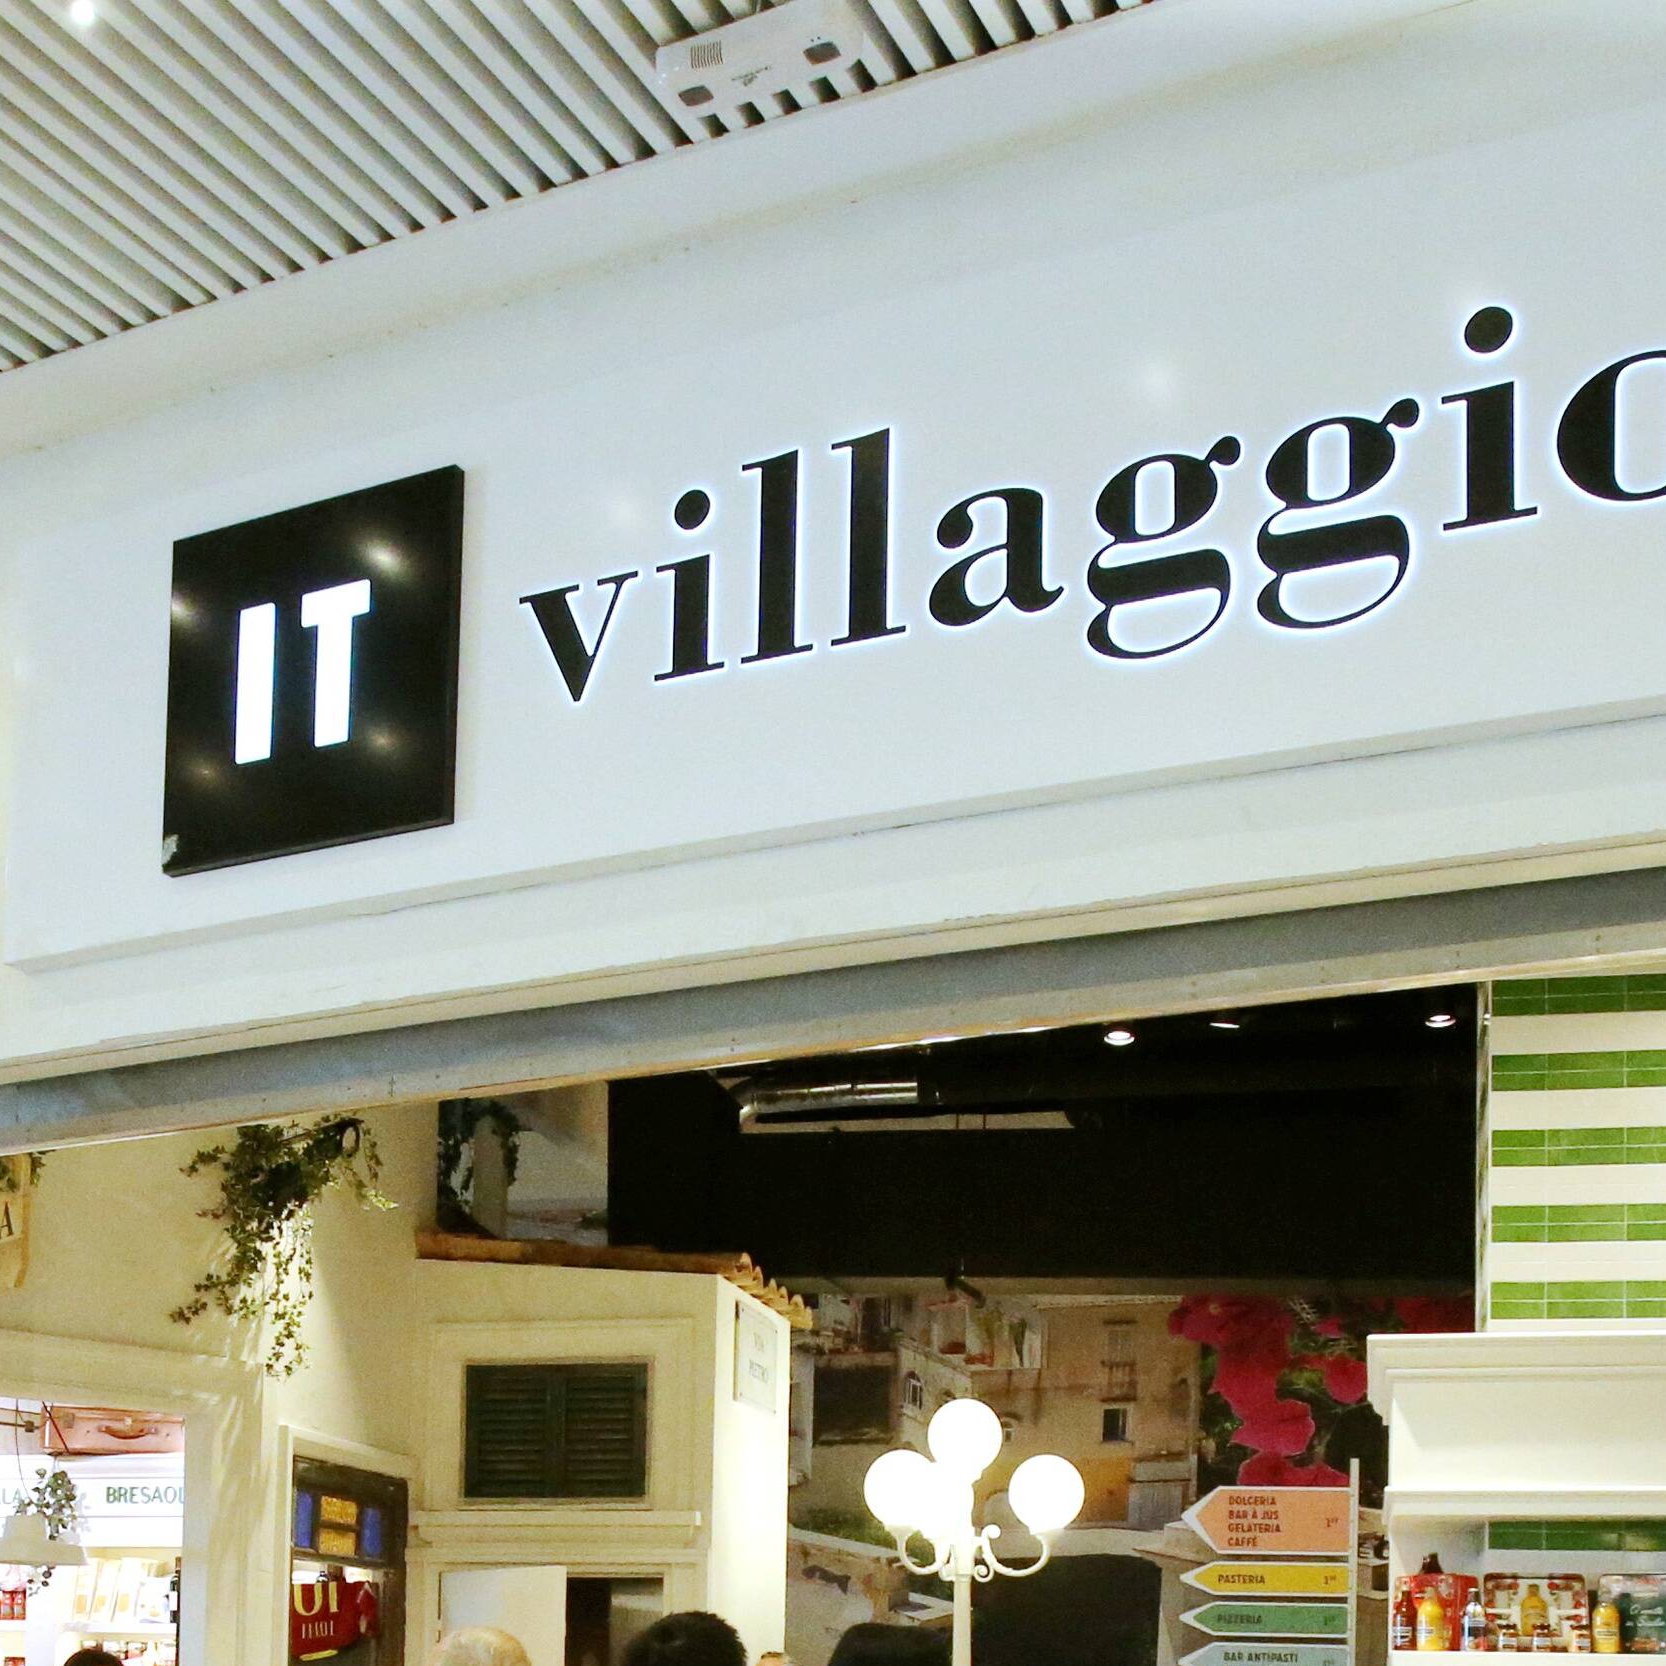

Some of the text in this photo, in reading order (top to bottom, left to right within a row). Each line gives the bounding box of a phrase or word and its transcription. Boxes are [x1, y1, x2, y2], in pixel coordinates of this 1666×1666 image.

[234, 578, 372, 766] IT
[1228, 1495, 1277, 1506] DOLCERIA
[1228, 1509, 1248, 1520] BAR
[1260, 1509, 1279, 1520] JUS
[1227, 1522, 1282, 1534] GELATERIA
[1217, 1573, 1266, 1585] PASTERIA
[1216, 1613, 1263, 1625] PIZZERIA
[1223, 1651, 1299, 1664] BAR ANTIPASTI
